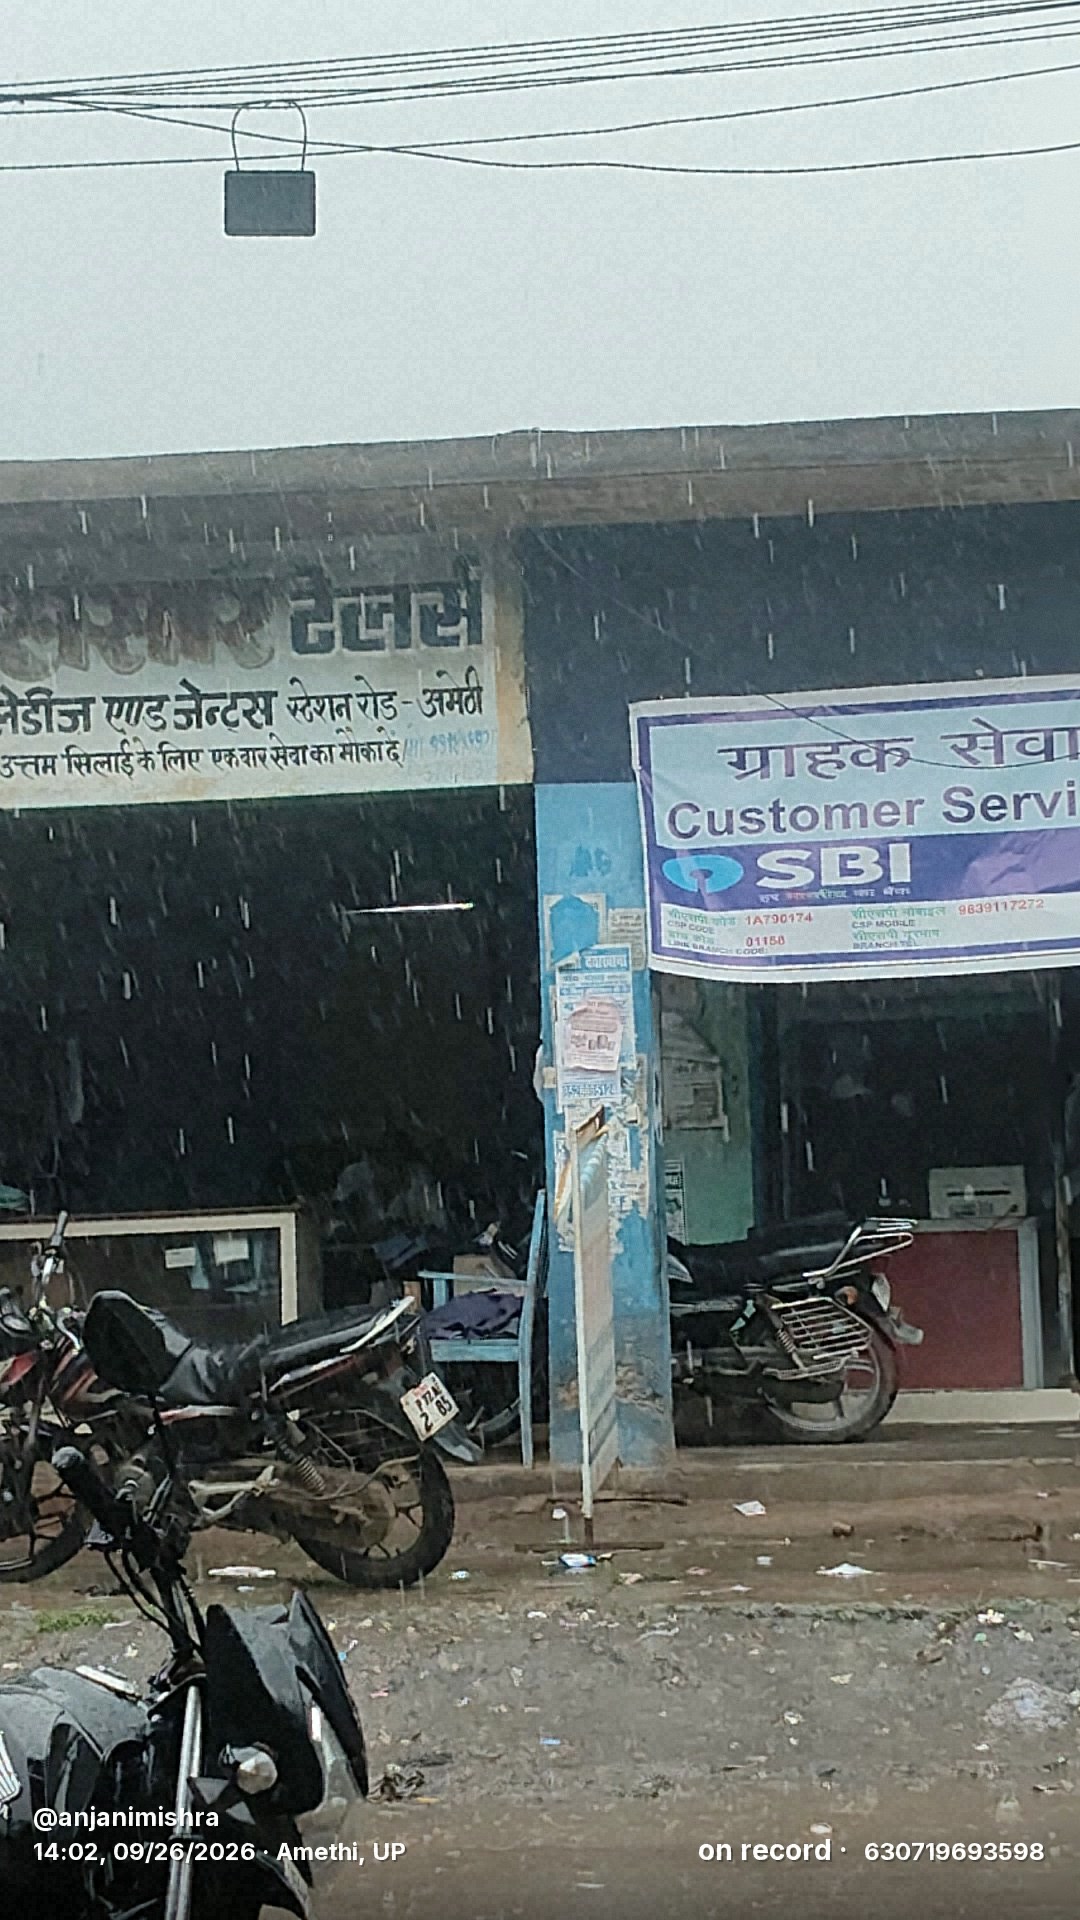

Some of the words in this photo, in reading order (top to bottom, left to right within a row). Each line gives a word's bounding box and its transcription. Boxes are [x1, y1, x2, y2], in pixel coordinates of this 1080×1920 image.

[287, 677, 353, 725] स्टेशन
[416, 665, 483, 718] अमेठी
[1, 754, 58, 779] उत्तम
[61, 739, 134, 780] सिलाई
[133, 736, 155, 772] के
[157, 741, 204, 773] लिए
[269, 732, 308, 771] सेवा
[310, 744, 336, 765] का
[336, 726, 384, 763] मौका
[717, 737, 914, 781] ग्राहक
[941, 717, 1080, 766] सेवा
[667, 797, 925, 840] Customer
[942, 780, 1077, 824] Servi
[756, 842, 911, 889] SBI
